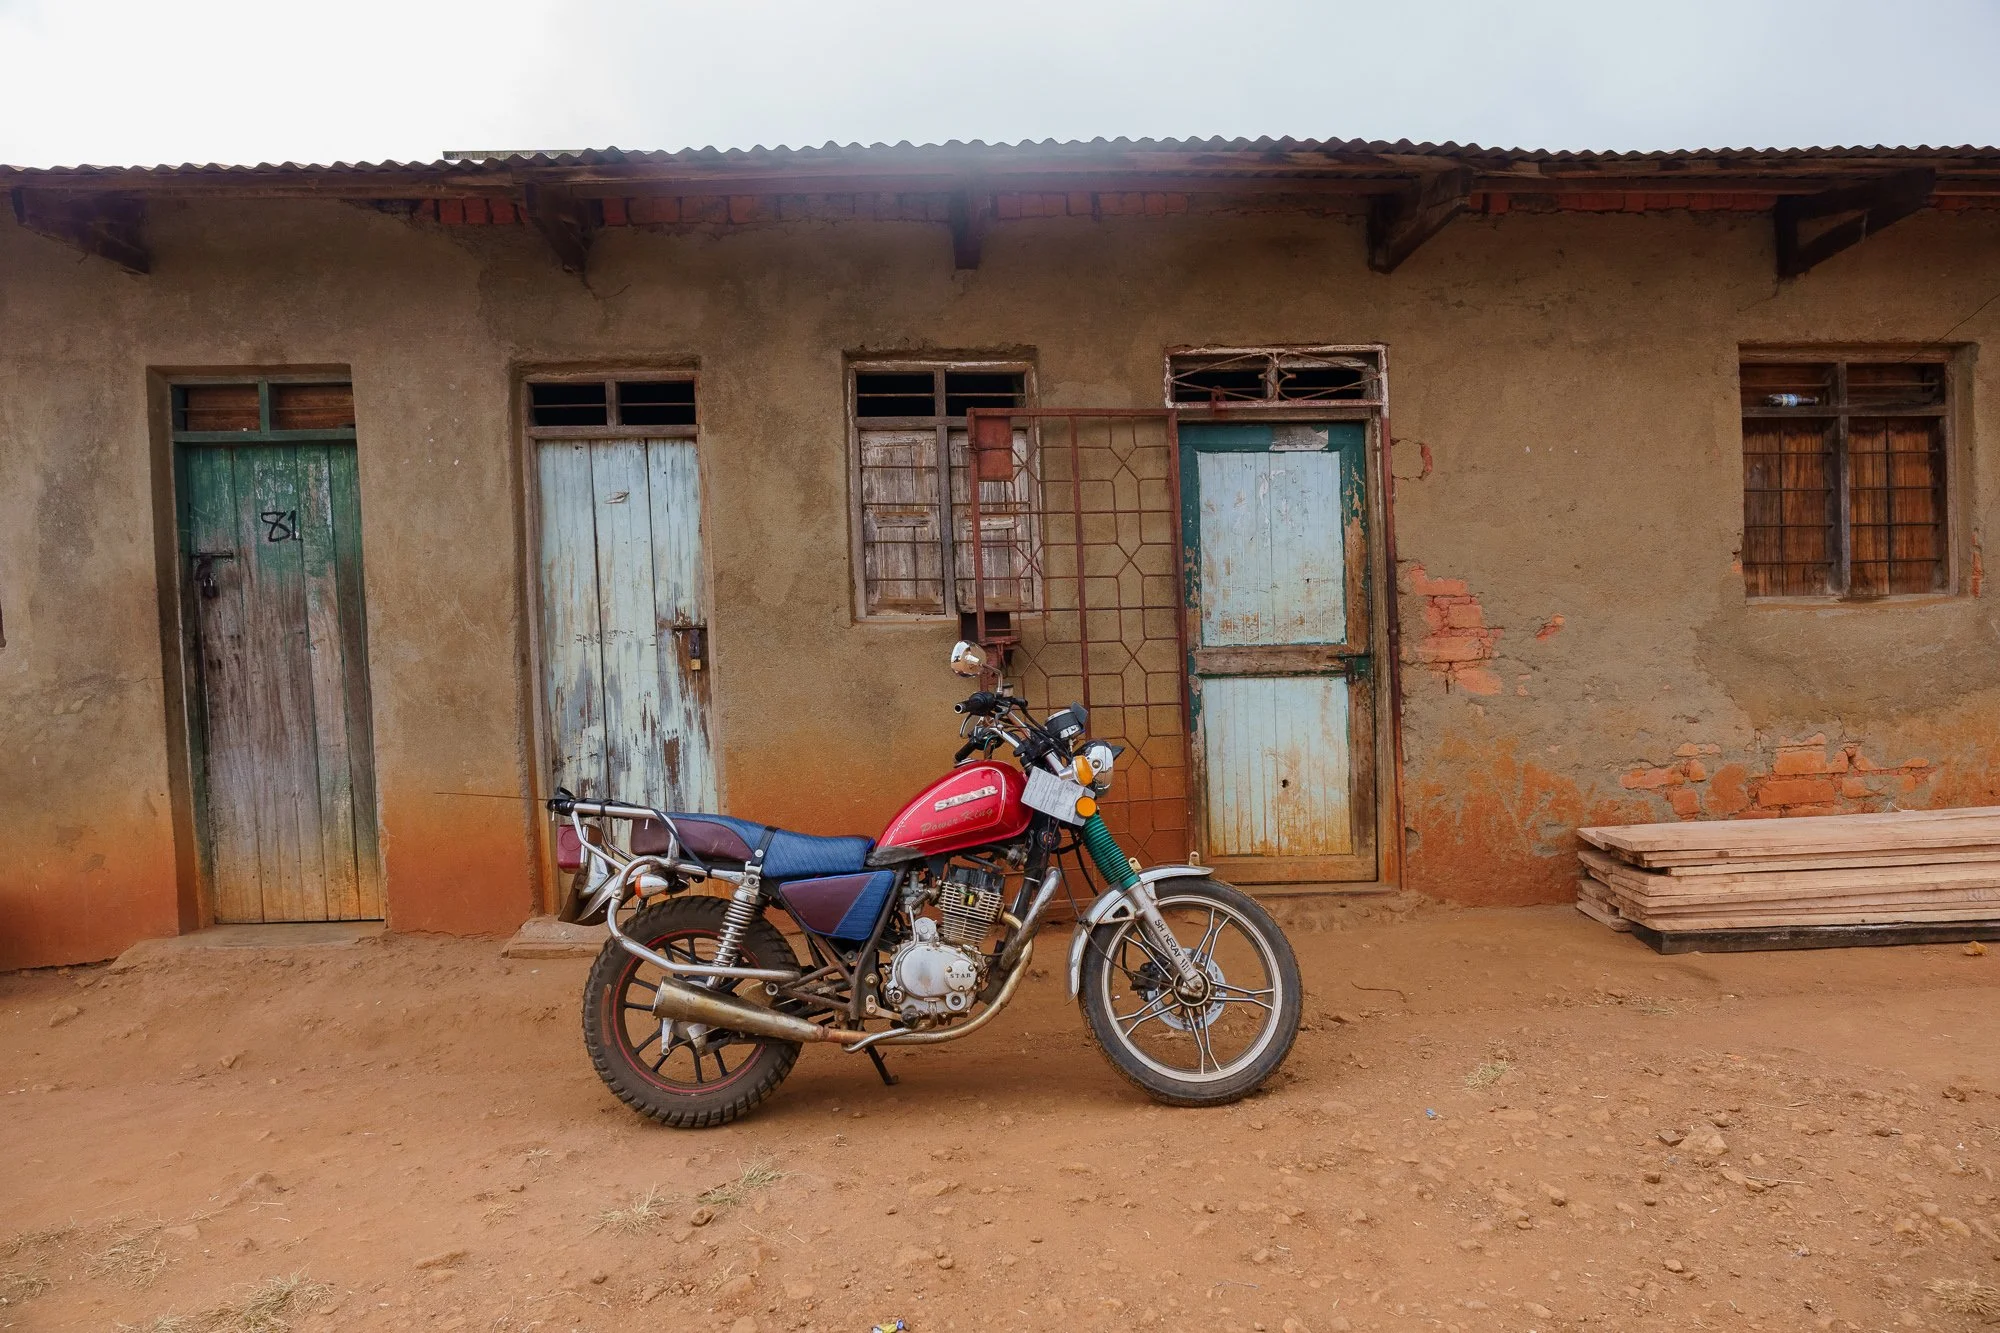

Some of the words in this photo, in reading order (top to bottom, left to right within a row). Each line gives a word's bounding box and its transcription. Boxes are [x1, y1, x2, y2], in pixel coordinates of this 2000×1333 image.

[261, 510, 303, 542] 81
[934, 785, 998, 812] STAR
[920, 817, 958, 836] Power
[960, 808, 993, 822] King
